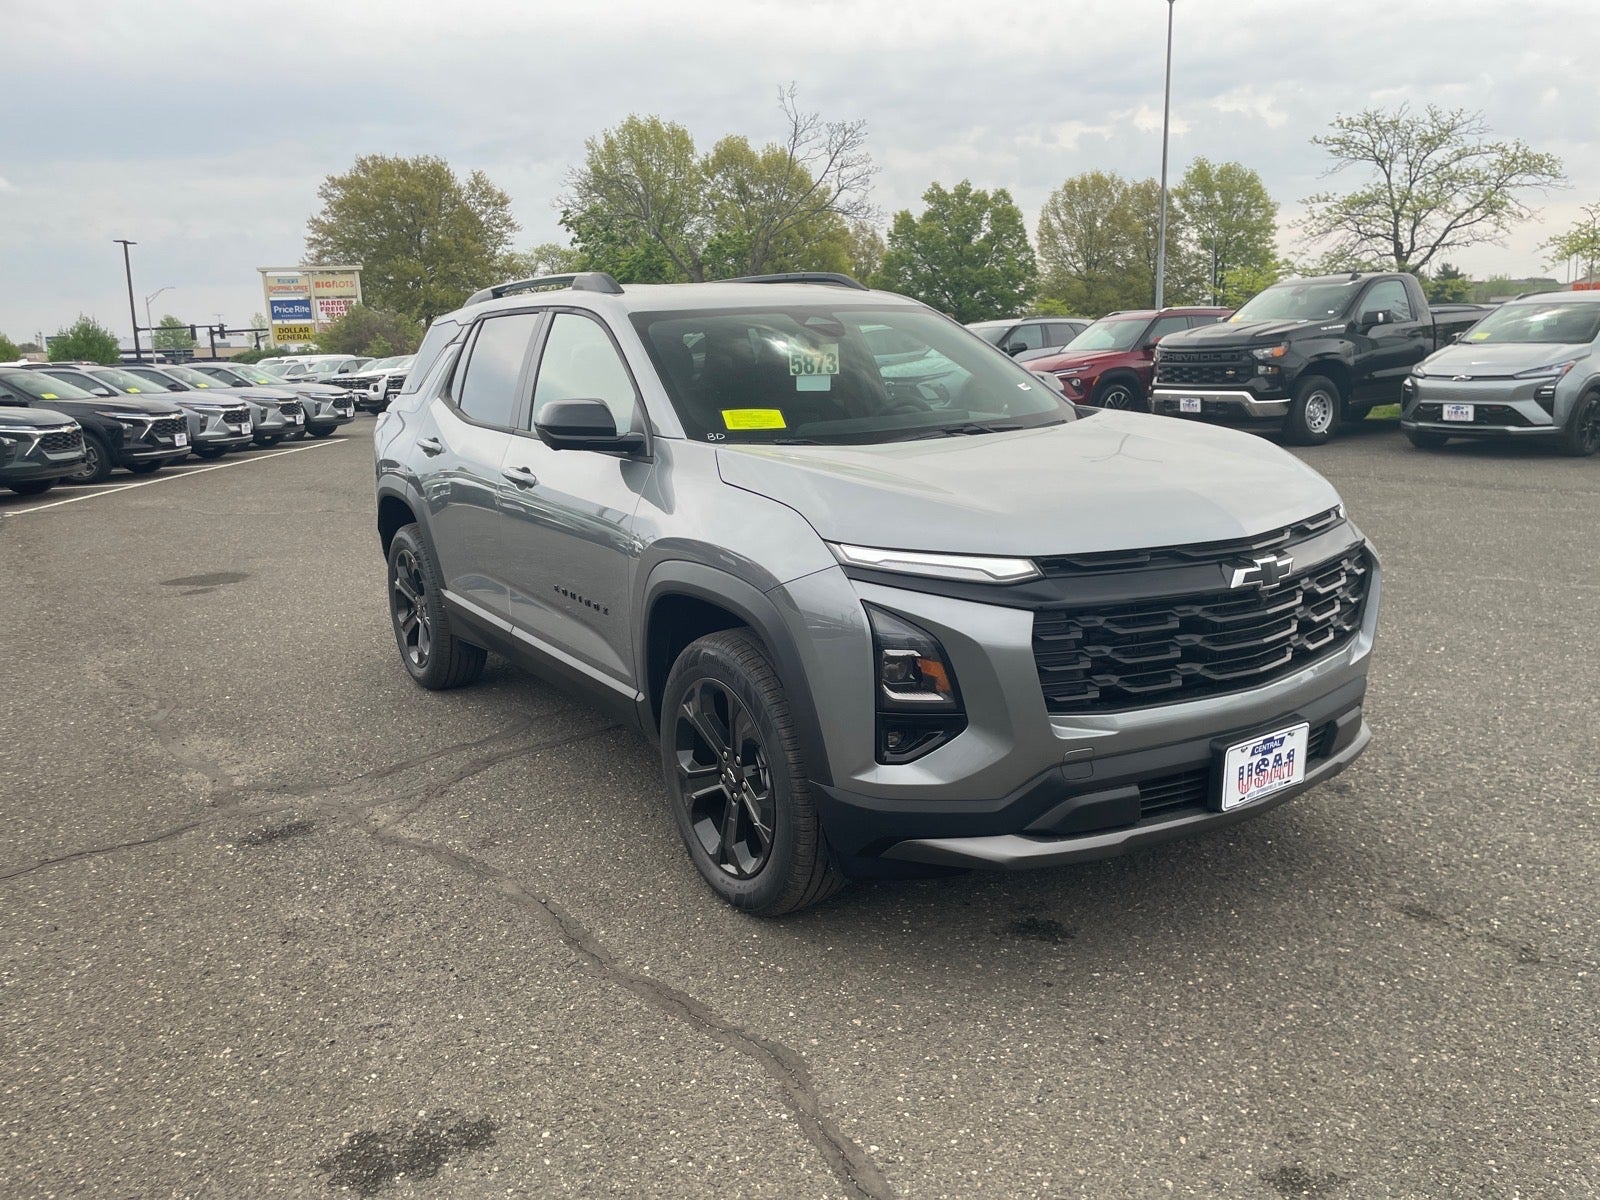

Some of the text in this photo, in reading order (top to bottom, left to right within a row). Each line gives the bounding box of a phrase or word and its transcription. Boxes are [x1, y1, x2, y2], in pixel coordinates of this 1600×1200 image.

[273, 305, 310, 314] Price Rite
[791, 353, 837, 375] 5873
[1254, 738, 1282, 754] CENTRAL
